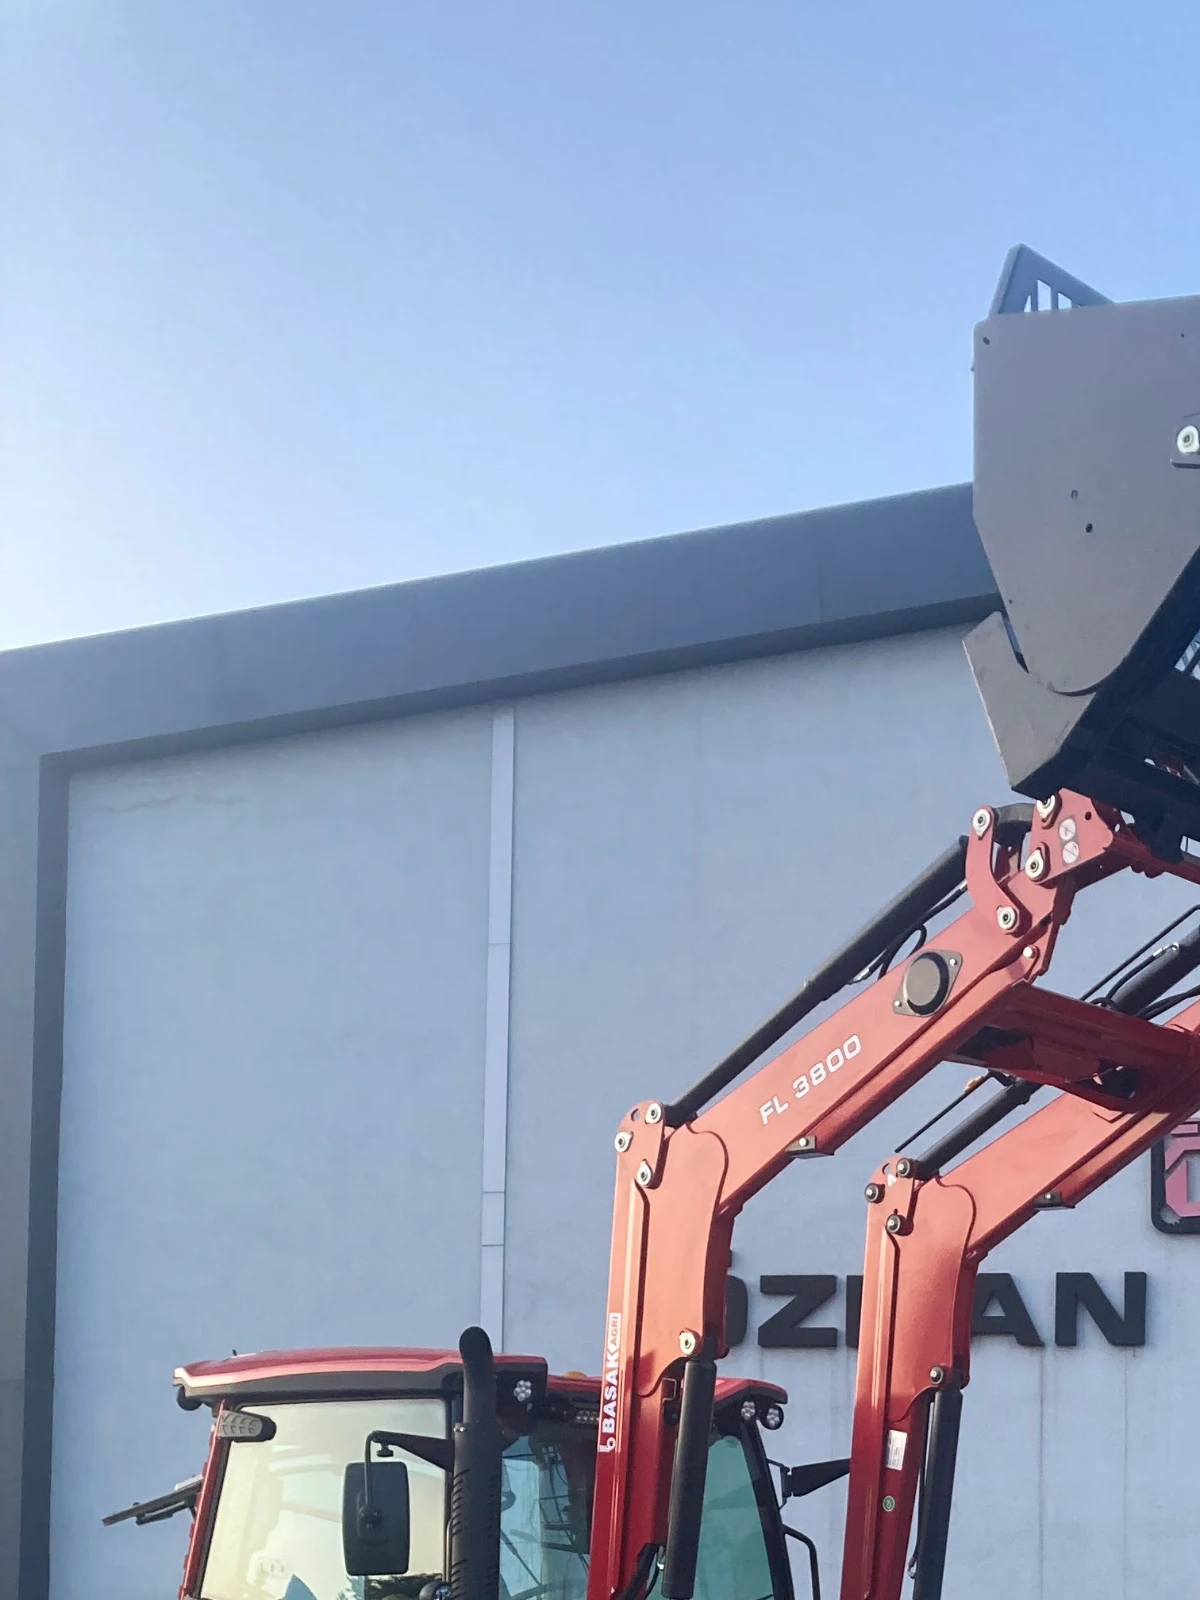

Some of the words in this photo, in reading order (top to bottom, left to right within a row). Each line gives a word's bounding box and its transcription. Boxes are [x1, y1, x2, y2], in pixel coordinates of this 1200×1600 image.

[758, 1095, 790, 1126] FL
[792, 1033, 863, 1100] 3800
[610, 1315, 620, 1346] AGRI
